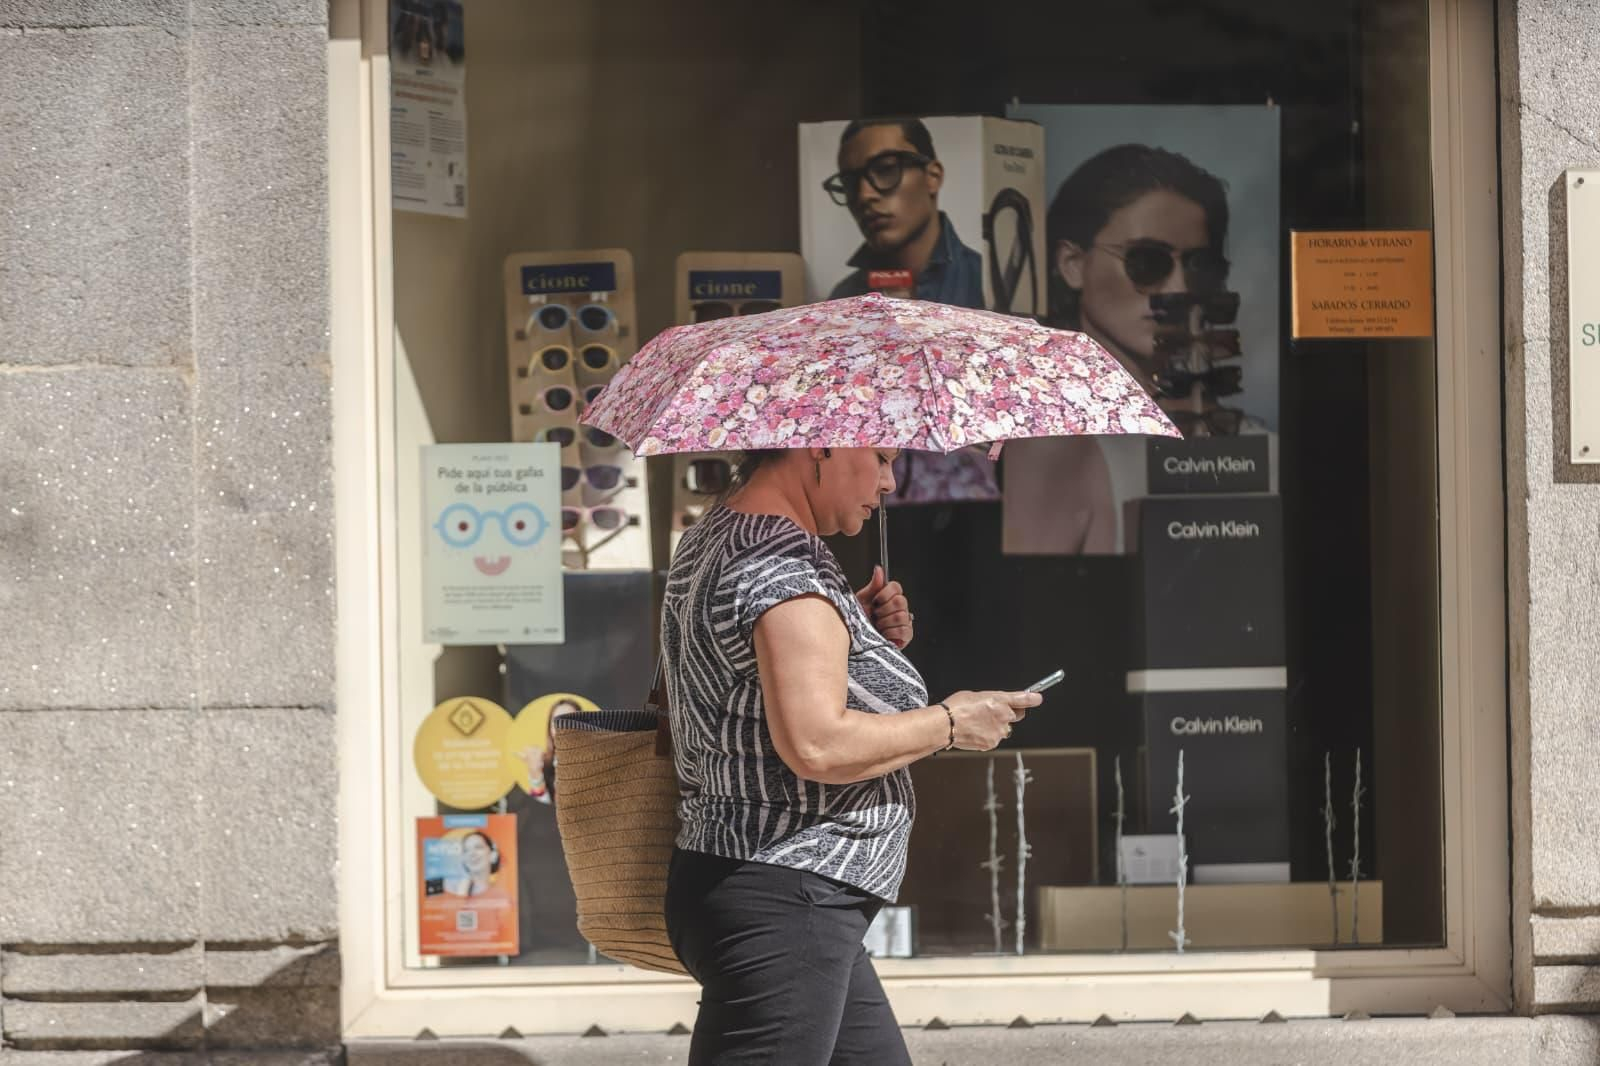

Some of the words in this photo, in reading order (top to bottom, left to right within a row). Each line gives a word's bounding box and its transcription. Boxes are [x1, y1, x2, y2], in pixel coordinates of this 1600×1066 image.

[1308, 238, 1357, 248] HORARIO
[1368, 237, 1413, 248] VERANO
[527, 273, 590, 290] cione
[694, 279, 758, 296] cione
[1360, 299, 1411, 311] CERRADO
[1582, 323, 1600, 346] S
[438, 467, 464, 479] Pide
[494, 468, 513, 479] tus
[515, 465, 545, 481] gafas
[1163, 457, 1215, 474] Calvin
[1217, 456, 1256, 473] Klein
[455, 482, 470, 494] de
[473, 481, 484, 493] la
[1168, 522, 1219, 539] Calvin
[1221, 520, 1259, 537] Klein
[1170, 716, 1223, 734] Calvin
[1224, 715, 1263, 732] Klein
